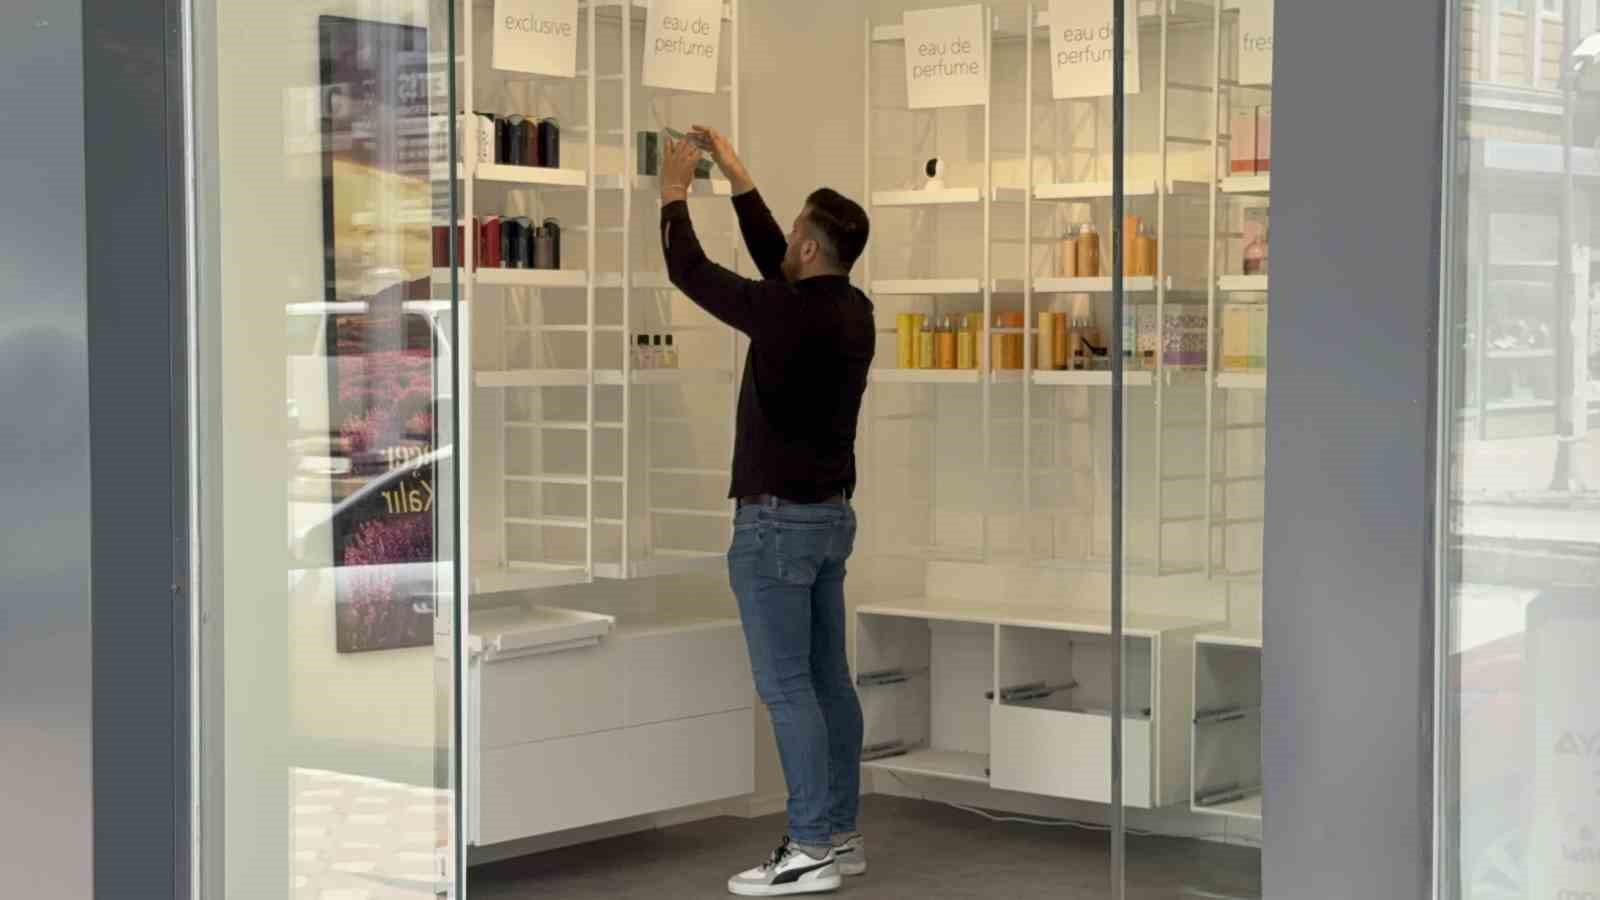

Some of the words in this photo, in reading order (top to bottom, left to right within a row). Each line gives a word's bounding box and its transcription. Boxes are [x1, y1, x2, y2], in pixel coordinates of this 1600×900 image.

[503, 12, 572, 37] exclusive
[663, 15, 689, 32] eau
[691, 14, 711, 35] de
[1063, 27, 1094, 42] eau
[655, 35, 714, 58] perfume
[918, 40, 946, 56] eau
[951, 35, 971, 55] de
[912, 57, 980, 80] perfume
